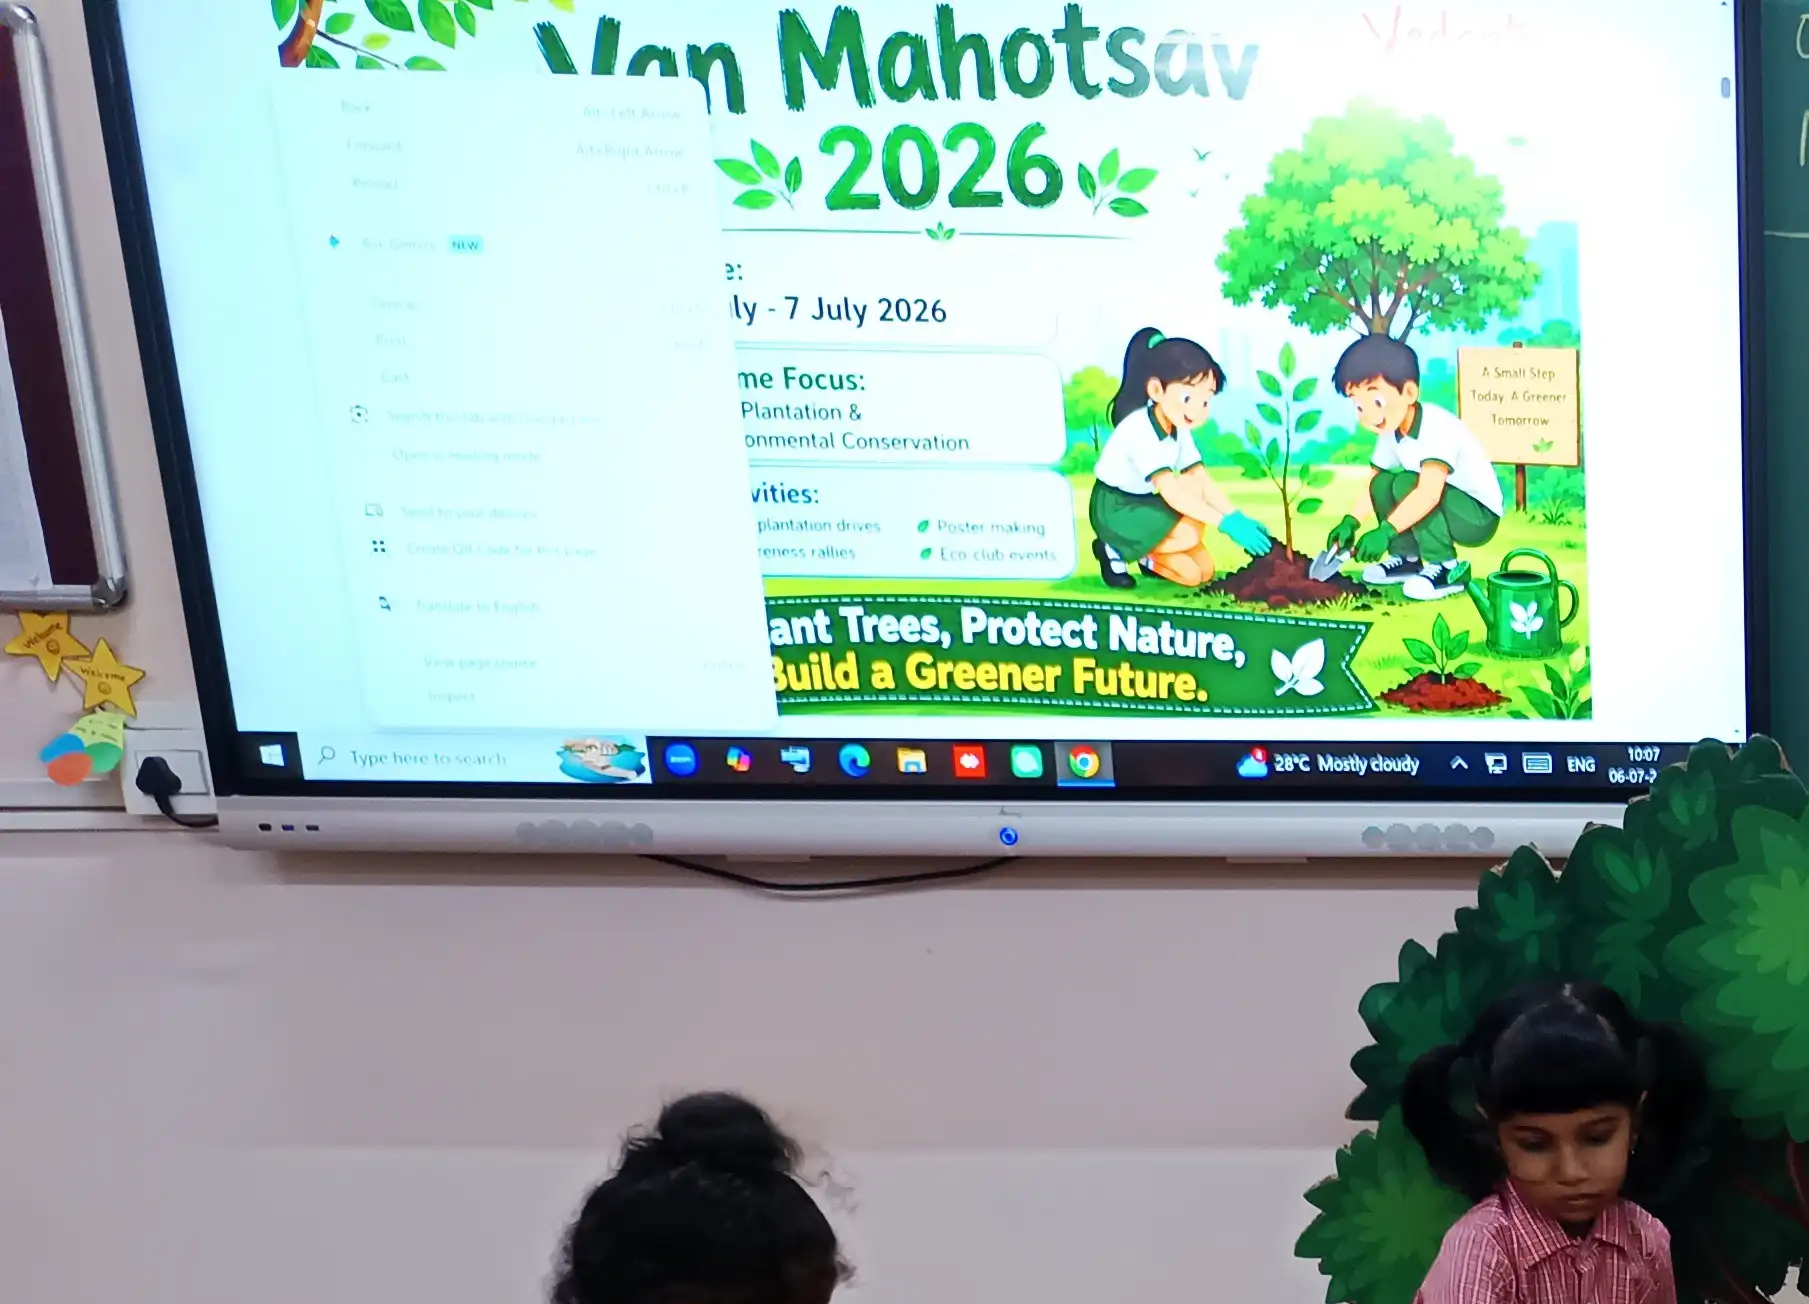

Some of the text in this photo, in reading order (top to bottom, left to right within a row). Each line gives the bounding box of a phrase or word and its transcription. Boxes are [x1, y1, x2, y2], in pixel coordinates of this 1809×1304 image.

[777, 2, 1258, 112] Mahotsav
[819, 121, 1063, 211] 2026
[784, 296, 799, 320] 7
[812, 296, 867, 328] July
[878, 297, 947, 323] 2026
[783, 366, 866, 391] Focus:
[1482, 366, 1556, 382] A Small Step
[1511, 390, 1519, 401] A
[1523, 391, 1568, 403] Greener
[742, 401, 862, 421] Plantation &
[1492, 413, 1550, 427] Tomorrow
[842, 432, 970, 451] Conservation
[758, 518, 882, 535] plantation drives
[938, 519, 1046, 538] Poster making
[810, 546, 856, 560] rallies
[1009, 548, 1058, 563] events
[838, 605, 953, 649] Trees,
[960, 605, 1098, 650] Protect
[1109, 614, 1246, 669] Nature,
[773, 651, 1209, 703] Build a Greener Future.
[352, 751, 507, 768] Type here to search
[1628, 746, 1660, 762] 10:07
[1274, 754, 1420, 776] 28°C Mostly cloudy
[1567, 756, 1596, 772] ENG
[1608, 767, 1658, 784] 06-07-2
